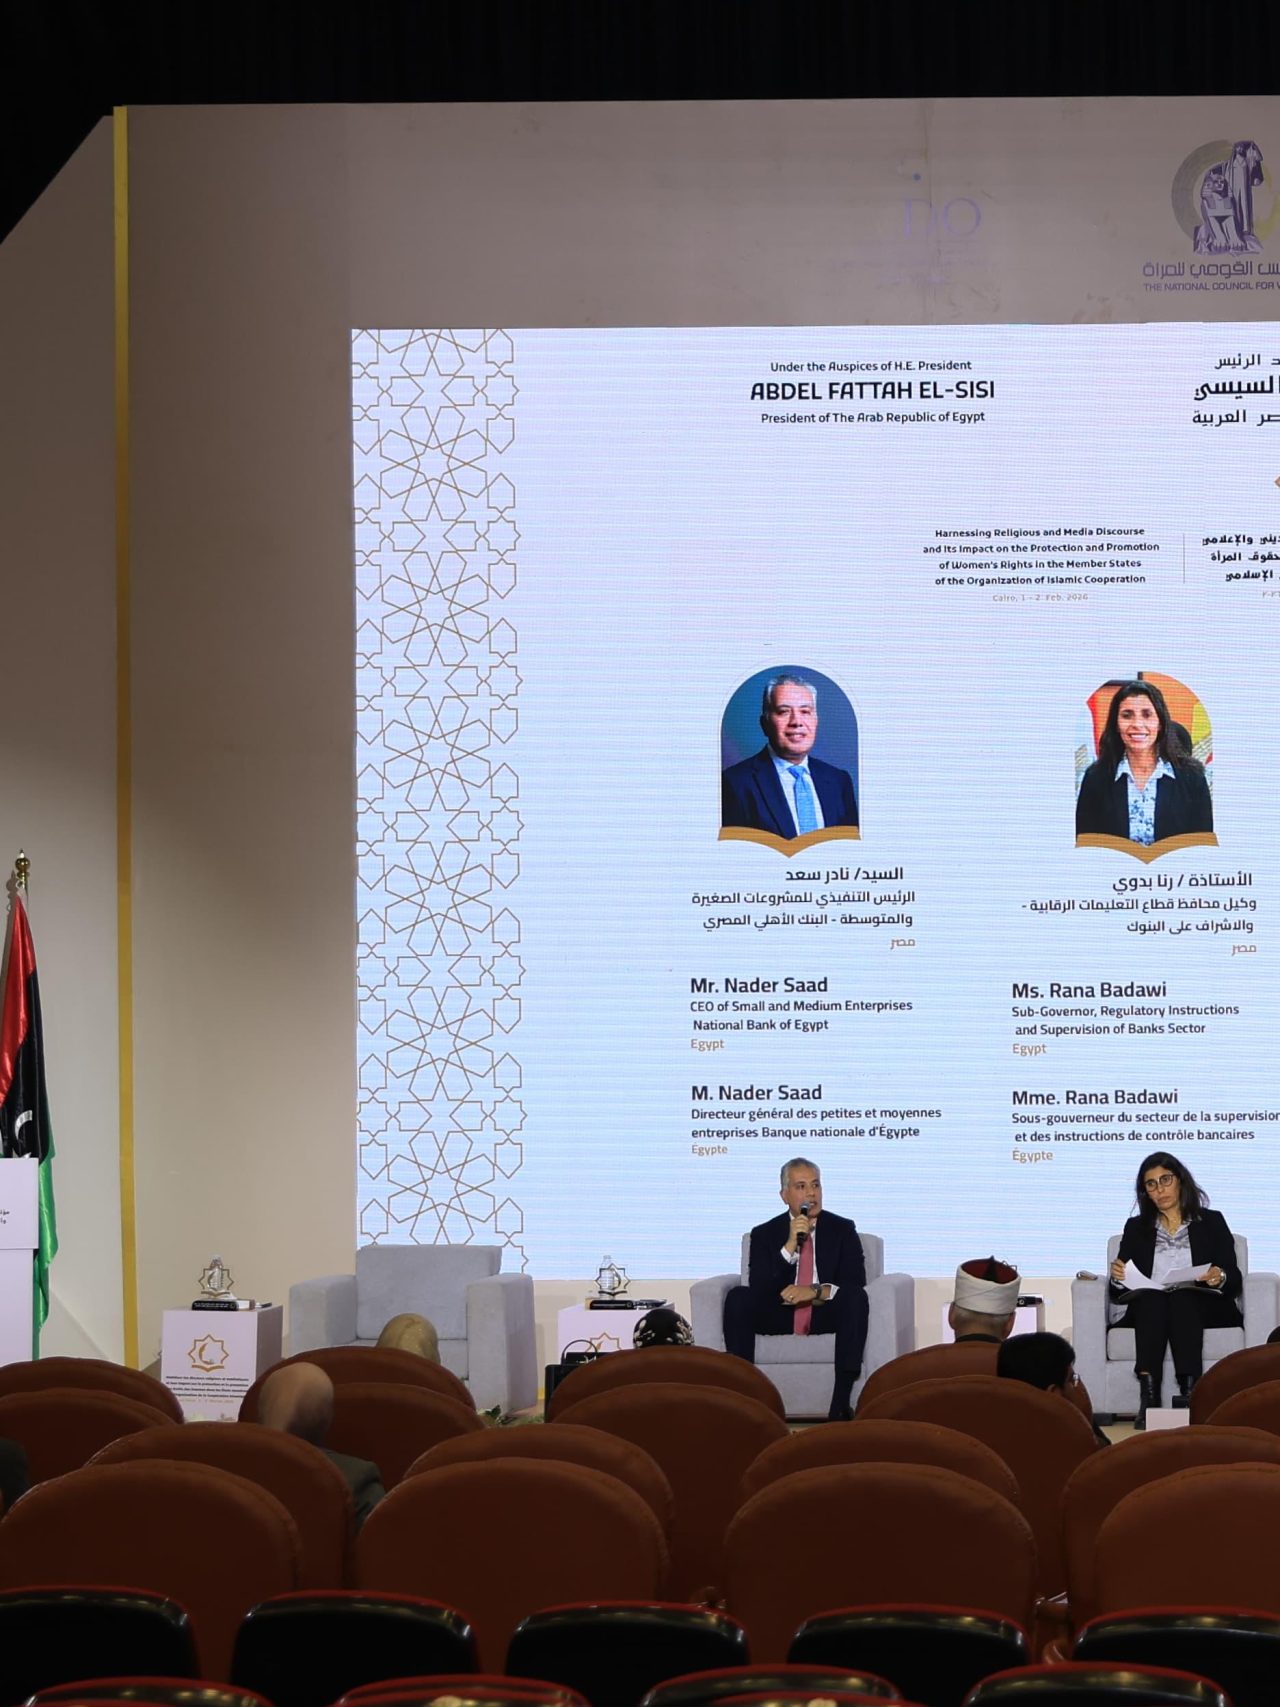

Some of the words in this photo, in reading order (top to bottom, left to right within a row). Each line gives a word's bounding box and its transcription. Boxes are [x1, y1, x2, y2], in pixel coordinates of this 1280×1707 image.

[1189, 260, 1253, 280] القومي
[1143, 283, 1163, 292] THE
[1164, 281, 1212, 292] NATIONAL
[1211, 281, 1254, 291] COUNCIL
[1255, 281, 1275, 291] FOR
[770, 361, 805, 373] Under
[806, 361, 827, 372] the
[828, 361, 879, 374] Auspices
[880, 360, 893, 372] of
[894, 360, 916, 371] H.E.
[918, 360, 973, 371] President
[750, 382, 823, 401] ABDEL
[828, 381, 913, 400] FATTAH
[919, 380, 995, 399] EL-SISI
[761, 412, 816, 424] President
[818, 412, 832, 423] of
[832, 412, 855, 423] The
[856, 411, 884, 423] Arab
[886, 411, 936, 425] Republic
[938, 411, 951, 422] of
[952, 411, 986, 425] Egypt
[1192, 409, 1247, 428] العربية
[935, 528, 992, 539] Harnessing
[993, 528, 1041, 539] Religious
[1042, 527, 1062, 537] and
[1063, 527, 1094, 536] Media
[1095, 527, 1145, 536] Discourse
[785, 870, 821, 881] سعد
[824, 867, 850, 885] نادر
[853, 866, 904, 884] السيد/
[1157, 873, 1173, 892] رنا
[1188, 870, 1253, 887] الأستاذة
[1112, 877, 1153, 896] بدوي
[1126, 920, 1165, 935] البنوك
[1168, 920, 1192, 935] على
[1195, 917, 1254, 935] والاشراف
[690, 977, 719, 994] Mr.
[724, 976, 779, 994] Nader
[783, 976, 828, 993] Saad
[1012, 983, 1045, 999] Ms.
[1049, 982, 1096, 999] Rana
[1100, 980, 1167, 998] Badawi
[690, 1000, 715, 1013] CEO
[717, 1000, 730, 1012] of
[731, 1000, 765, 1012] Small
[768, 1000, 791, 1012] and
[793, 999, 842, 1012] Medium
[844, 999, 914, 1014] Enterprises
[1011, 1005, 1098, 1018] Sub-Governor,
[1100, 1004, 1166, 1019] Regulatory
[1168, 1003, 1240, 1016] Instructions
[690, 1038, 725, 1052] Egypt
[691, 1085, 714, 1101] M.
[718, 1084, 774, 1101] Nader
[778, 1083, 822, 1101] Saad
[1012, 1090, 1061, 1106] Mme.
[1065, 1089, 1110, 1105] Rana
[1114, 1088, 1178, 1105] Badawi
